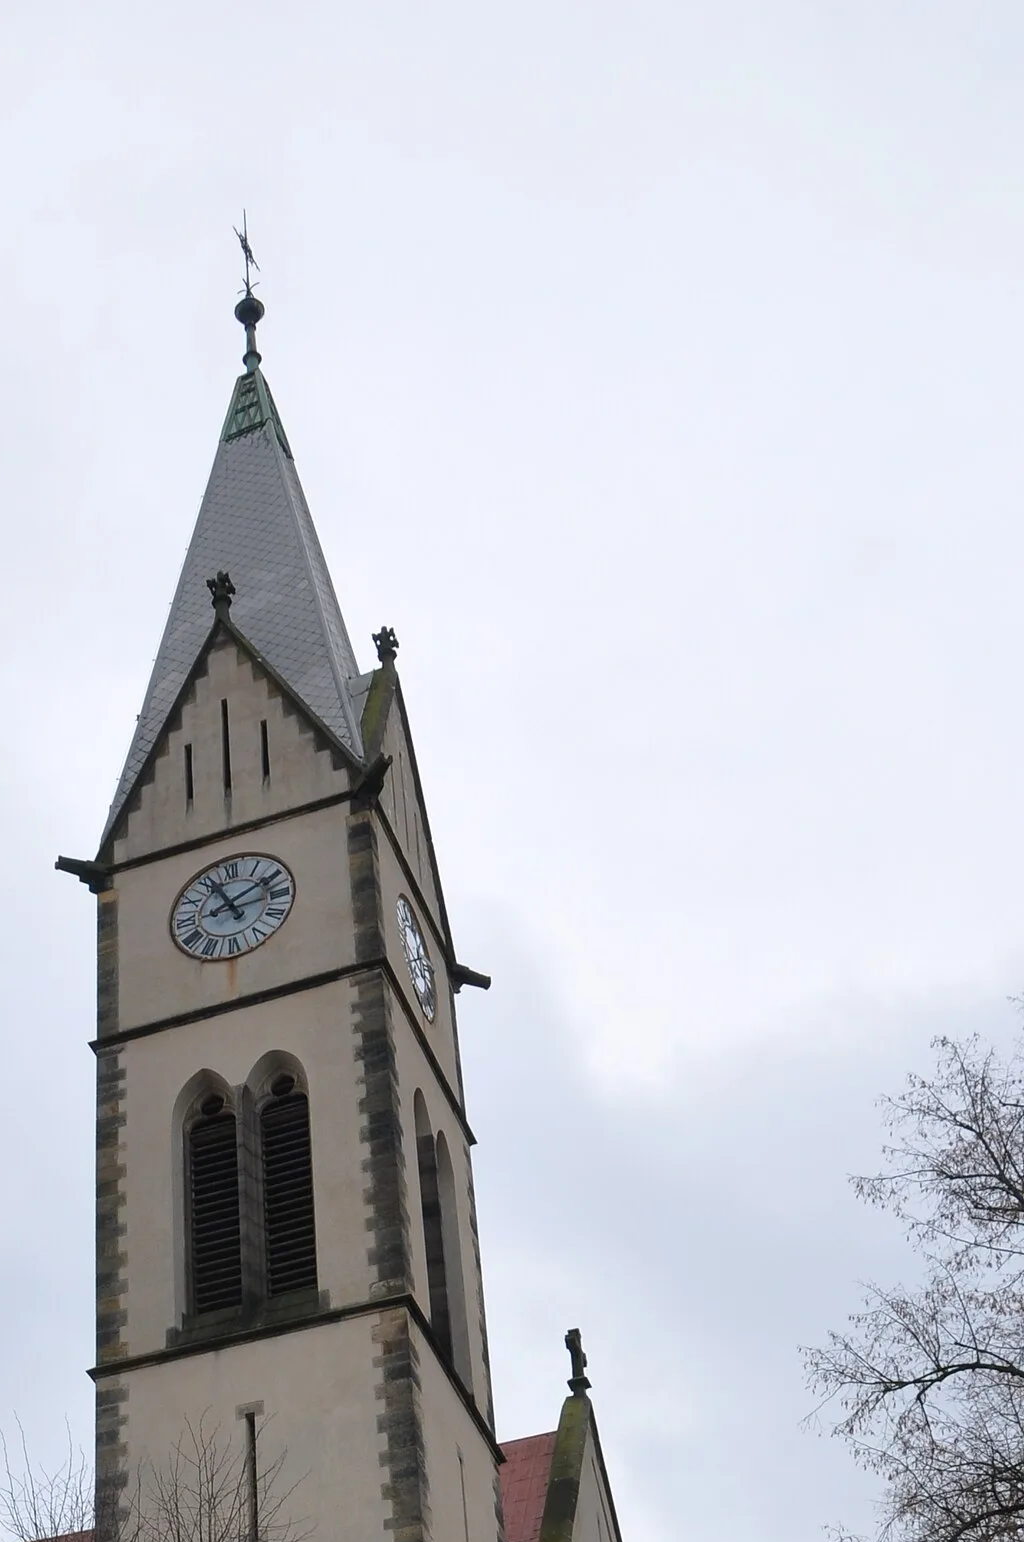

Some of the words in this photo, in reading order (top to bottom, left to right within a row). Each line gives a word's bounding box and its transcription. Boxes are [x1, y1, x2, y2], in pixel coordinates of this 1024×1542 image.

[224, 862, 239, 881] XII
[250, 861, 260, 877] I
[270, 886, 290, 900] III
[181, 896, 201, 907] X
[177, 914, 196, 929] IX
[266, 908, 285, 920] IV
[252, 927, 267, 942] V
[201, 938, 219, 956] VII
[228, 937, 241, 955] VI
